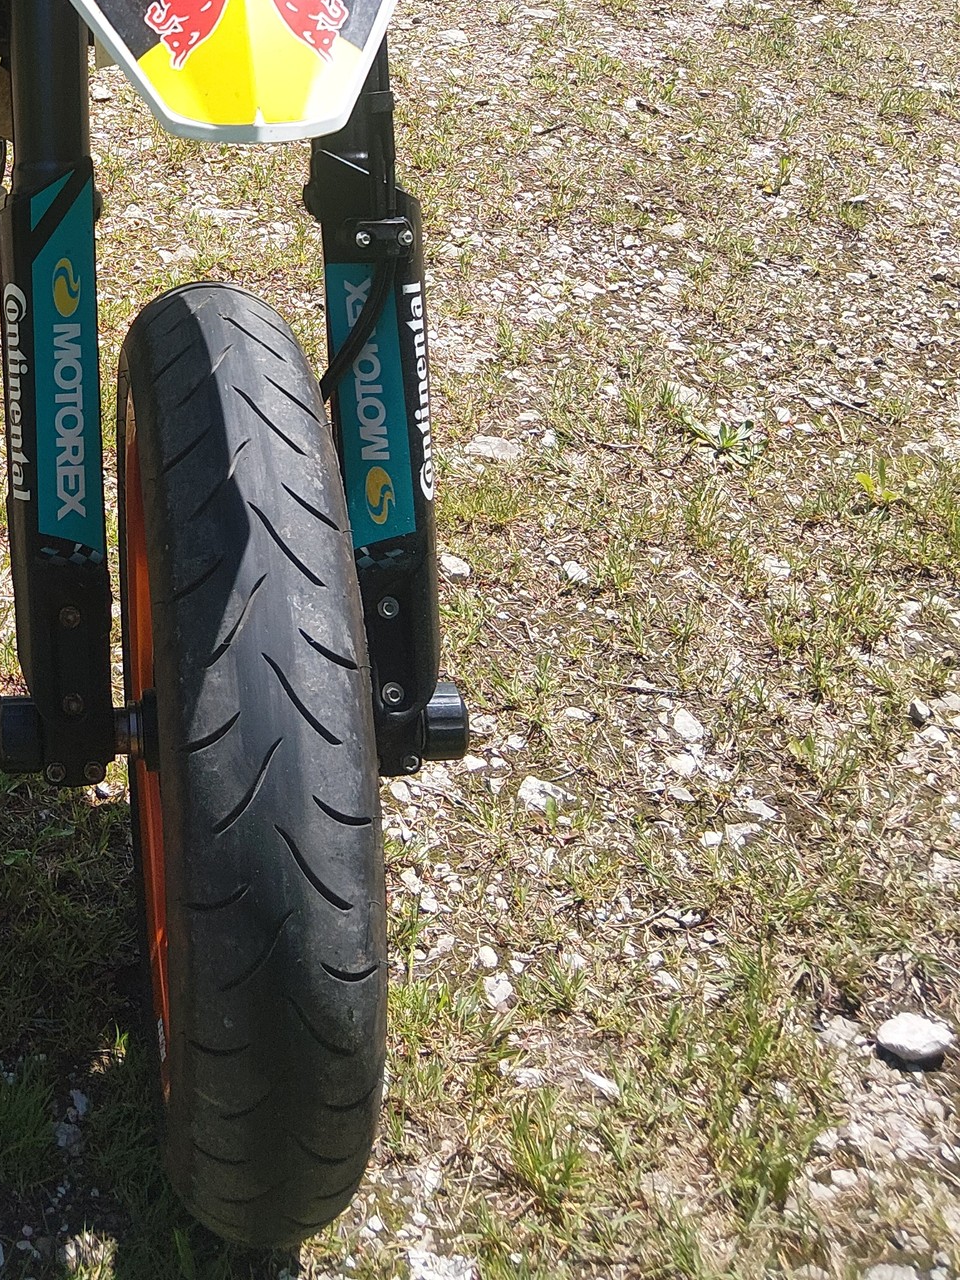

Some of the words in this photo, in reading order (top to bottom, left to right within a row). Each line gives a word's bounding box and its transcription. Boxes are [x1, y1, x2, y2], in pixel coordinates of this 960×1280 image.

[3, 282, 31, 502] Continental
[53, 323, 87, 521] MOTOREX
[402, 280, 434, 501] Continental
